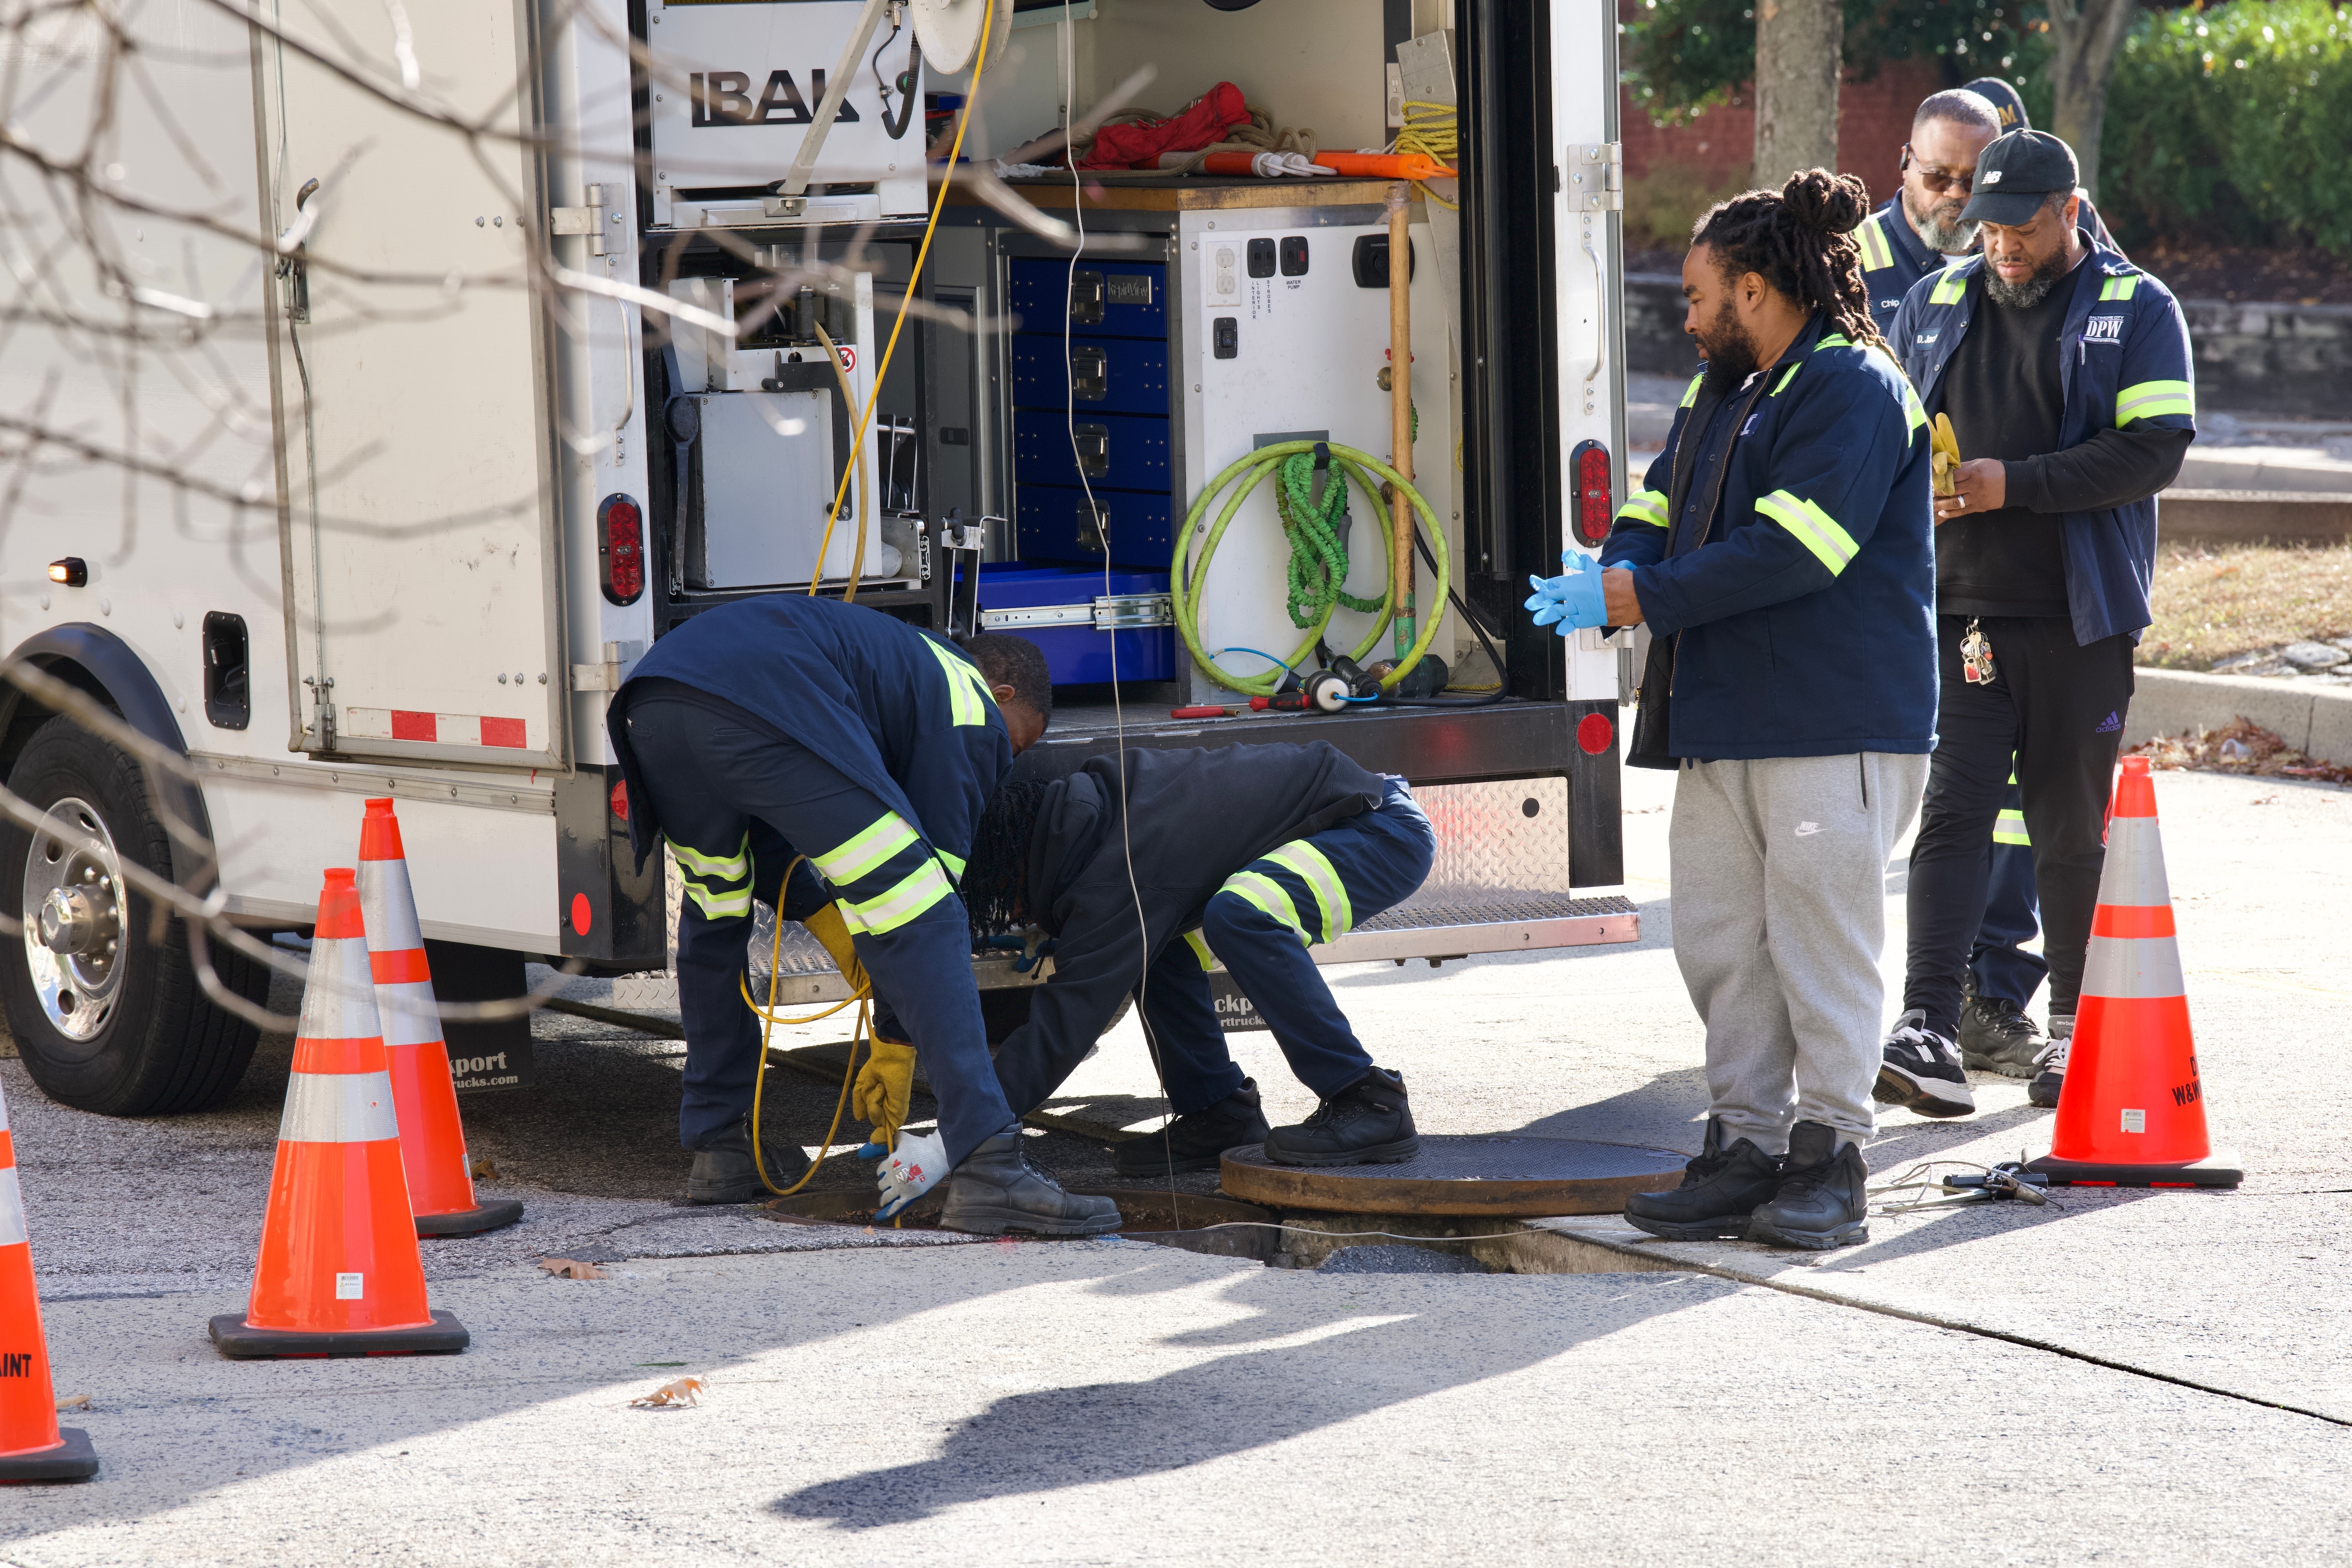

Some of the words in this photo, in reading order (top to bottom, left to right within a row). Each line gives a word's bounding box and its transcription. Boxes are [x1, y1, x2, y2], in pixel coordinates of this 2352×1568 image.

[1107, 279, 1148, 299] RapidView
[1881, 299, 1900, 309] Chip
[2084, 320, 2124, 338] DPW
[1917, 334, 1924, 344] D.
[2096, 723, 2121, 733] adidas
[1799, 821, 1819, 831] NIKE
[1219, 1015, 1267, 1027] rttrucks
[2189, 1055, 2199, 1077] D
[0, 1353, 32, 1378] INT
